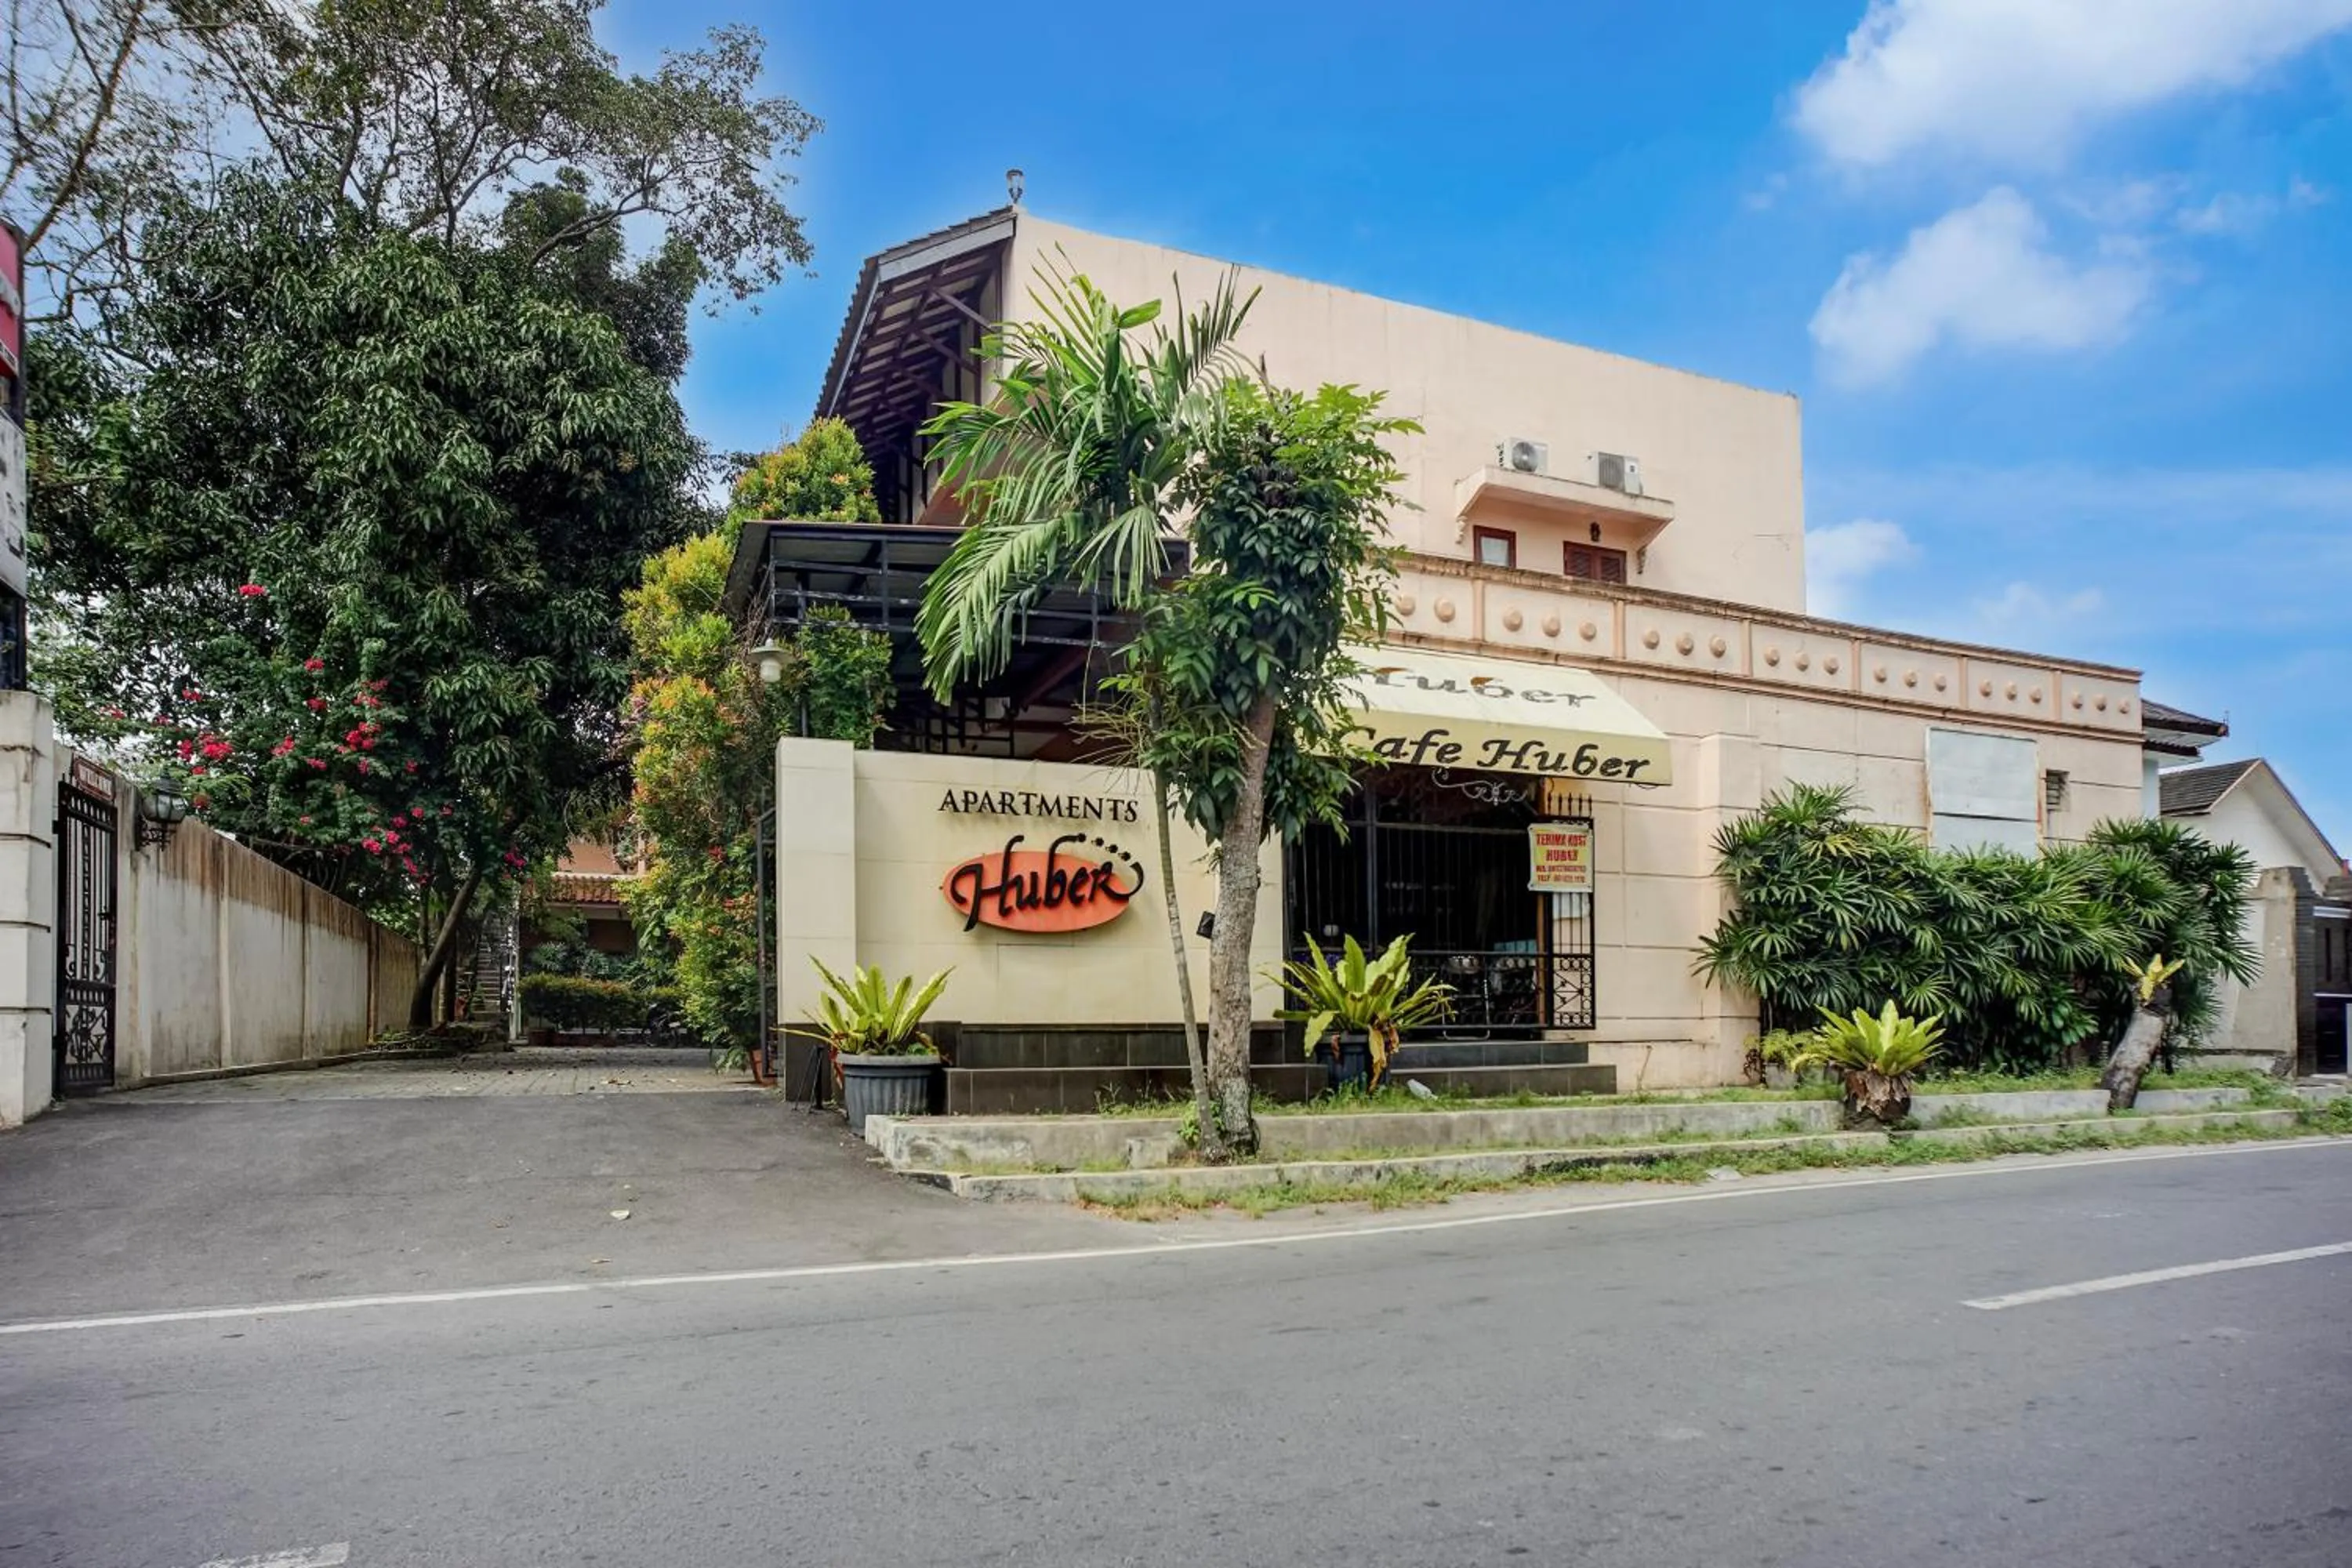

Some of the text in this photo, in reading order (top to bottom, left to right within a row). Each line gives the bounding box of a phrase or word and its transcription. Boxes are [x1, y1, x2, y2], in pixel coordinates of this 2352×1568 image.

[1476, 739, 1651, 779] Huber
[938, 789, 1139, 822] APARTMENTS
[949, 833, 1144, 931] Huber
